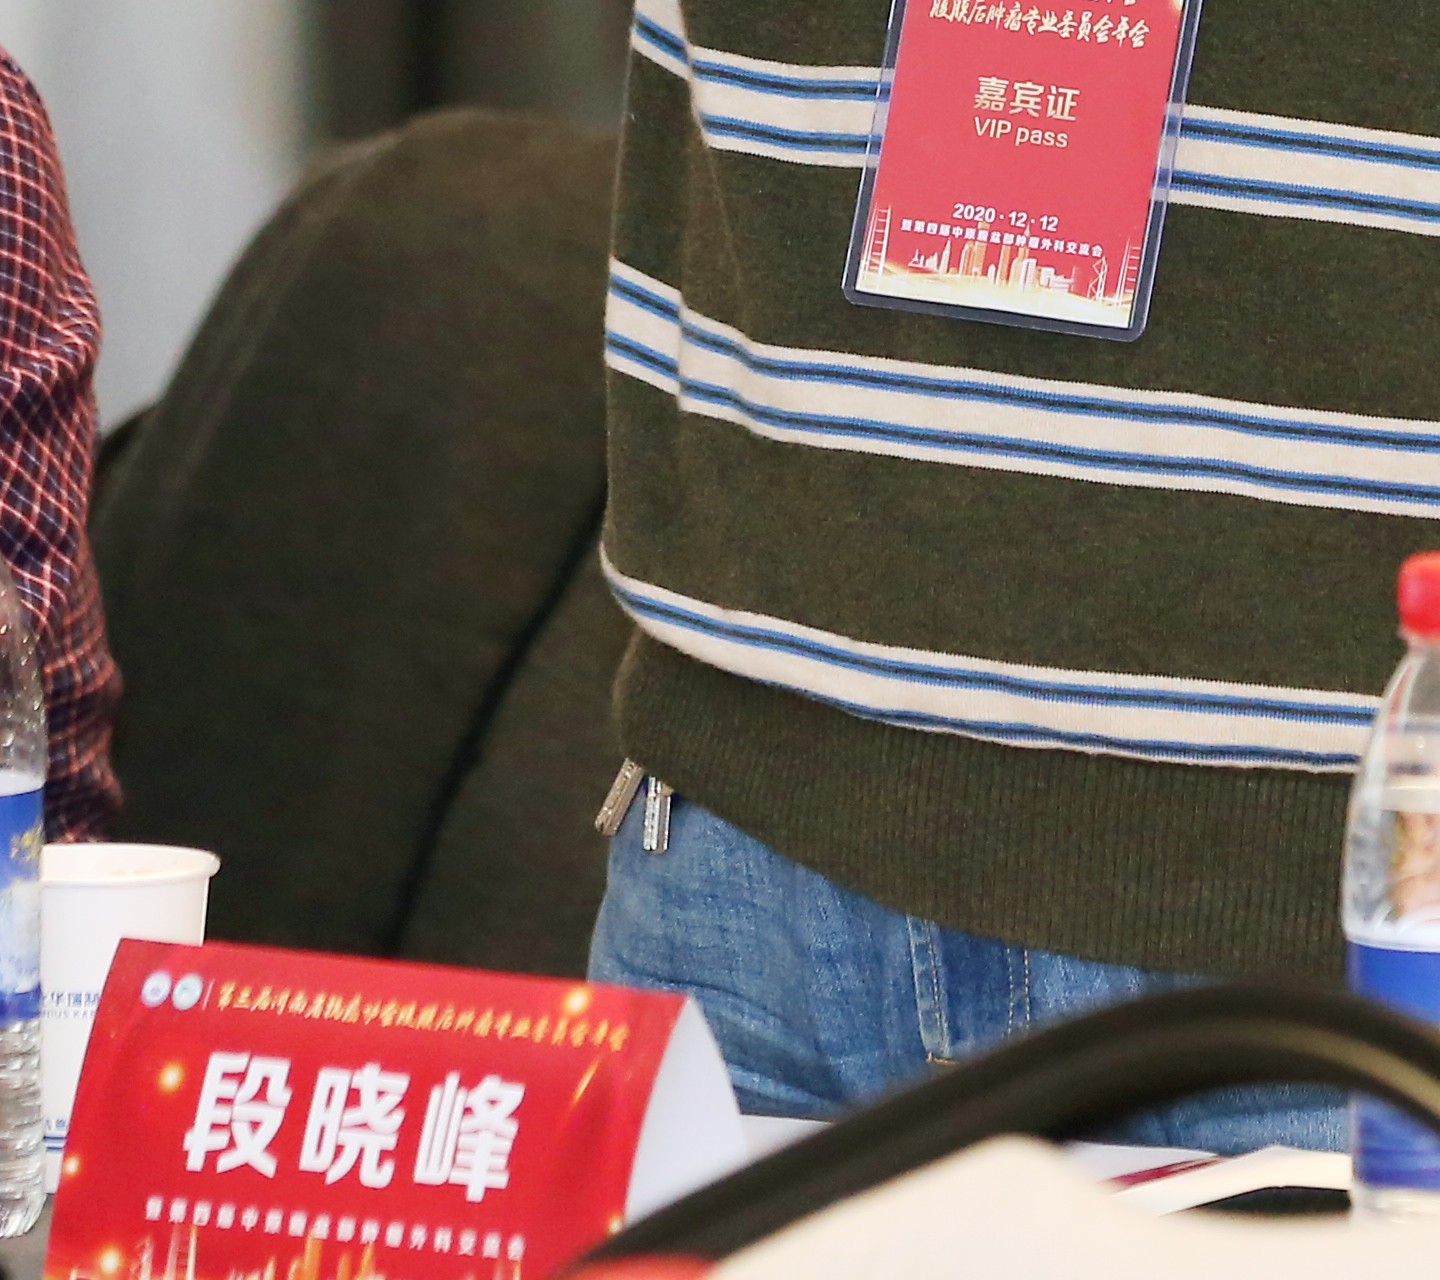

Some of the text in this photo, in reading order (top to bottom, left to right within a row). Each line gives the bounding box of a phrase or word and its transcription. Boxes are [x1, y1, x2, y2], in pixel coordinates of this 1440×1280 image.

[974, 76, 1081, 121] 嘉宾证
[974, 116, 1069, 148] VIP pass
[182, 1050, 527, 1203] 段晓峰
